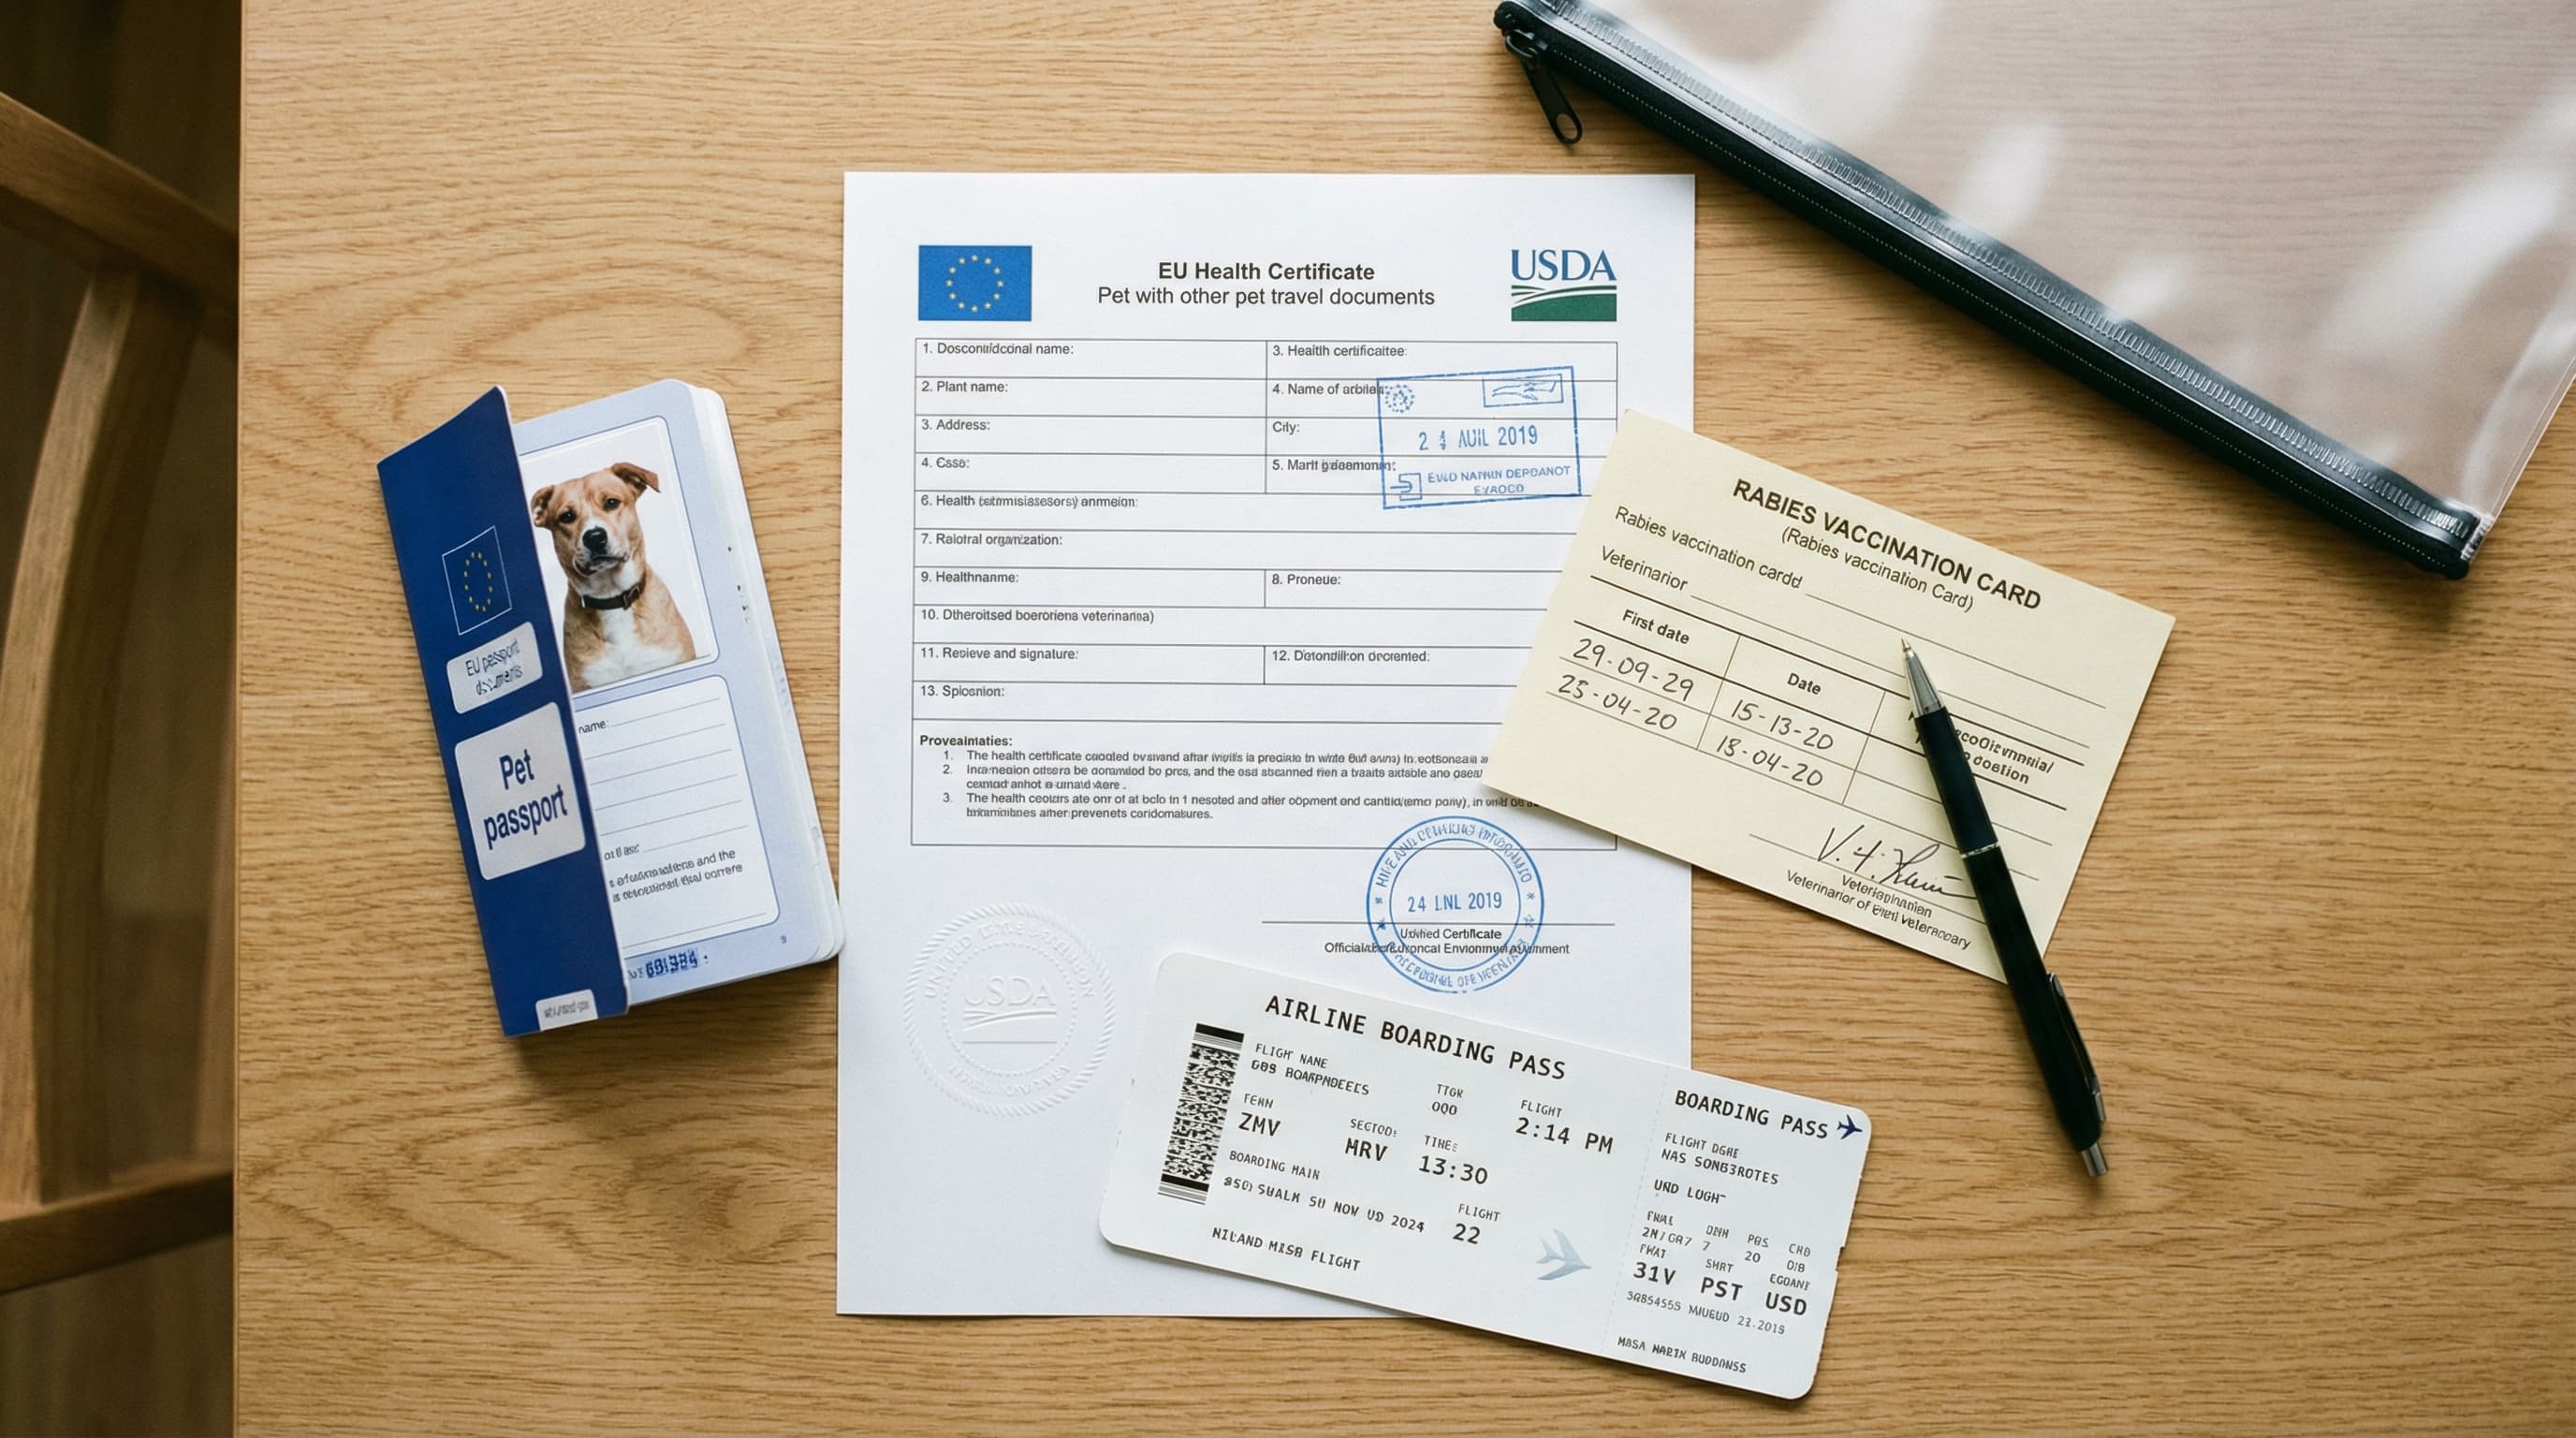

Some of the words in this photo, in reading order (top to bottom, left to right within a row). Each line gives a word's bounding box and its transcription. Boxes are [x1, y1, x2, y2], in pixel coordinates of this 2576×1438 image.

[1159, 262, 1187, 280] EU
[1195, 262, 1261, 280] Health
[1268, 262, 1375, 280] Certificate
[1512, 249, 1617, 281] USDA
[1099, 286, 1130, 304] Pet
[1135, 286, 1174, 304] with
[1180, 287, 1230, 304] other
[1236, 288, 1266, 309] pet
[1271, 287, 1323, 304] travel
[1329, 287, 1435, 305] documents
[923, 343, 932, 354] 1.
[1036, 345, 1074, 355] name:
[1273, 345, 1283, 356] 3.
[921, 380, 932, 392] 2.
[937, 381, 968, 392] Plant
[971, 383, 1009, 393] name:
[1272, 383, 1283, 394] 4.
[1288, 383, 1324, 394] Name
[1327, 383, 1339, 394] of
[922, 418, 932, 430] 3.
[936, 419, 990, 431] Address:
[1418, 432, 1428, 451] 2
[1498, 425, 1538, 447] 2019
[921, 457, 932, 468] 4.
[1272, 459, 1283, 471] 5.
[936, 494, 975, 506] Health
[921, 533, 932, 544] 7.
[1616, 506, 1667, 537] Rabies
[1672, 530, 1755, 571] vaccination
[1733, 478, 1817, 528] RABIES
[1824, 511, 1972, 584] VACCINATION
[1977, 573, 2041, 609] CARD
[921, 571, 931, 582] 9.
[1782, 525, 1839, 559] (Rabies
[1845, 551, 1927, 593] vaccination
[1932, 583, 1973, 613] Card)
[1272, 573, 1282, 584] 8.
[921, 609, 939, 620] 10.
[1622, 609, 1655, 635] First
[1652, 624, 1690, 644] date
[921, 647, 939, 659] 11.
[994, 647, 1017, 659] and
[1273, 650, 1290, 661] 12.
[921, 684, 938, 697] 13.
[1787, 672, 1822, 696] Date
[966, 750, 988, 760] The
[991, 750, 1026, 761] health
[500, 749, 534, 789] Pet
[1074, 765, 1088, 775] be
[1193, 766, 1215, 776] and
[1218, 767, 1236, 776] the
[966, 792, 988, 803] The
[991, 793, 1026, 803] health
[1237, 795, 1258, 805] and
[484, 785, 568, 850] passport
[1408, 896, 1427, 913] 24
[1468, 891, 1503, 910] 2019
[1857, 898, 1873, 911] of
[963, 976, 1057, 1006] USDA
[1266, 995, 1367, 1034] AIRLINE
[1381, 1020, 1495, 1064] BOARDING
[1509, 1050, 1565, 1079] PASS
[1521, 1100, 1562, 1118] FLIGHT
[1675, 1090, 1770, 1125] BOARDING
[1780, 1114, 1828, 1138] PASS
[1238, 1112, 1281, 1137] ZMV
[1515, 1117, 1570, 1145] 2:14
[1585, 1132, 1613, 1154] PM
[1665, 1133, 1706, 1151] FLIGHT
[1229, 1151, 1285, 1172] BOARDING
[1419, 1155, 1487, 1184] 13:30
[1458, 1203, 1500, 1221] FLIGHT
[1391, 1215, 1425, 1233] 2024
[1453, 1223, 1480, 1244] 22
[1310, 1250, 1361, 1270] FLIGHT
[1745, 1251, 1761, 1263] 20
[1633, 1261, 1676, 1285] 31V
[1701, 1276, 1743, 1301] PST
[1765, 1292, 1807, 1315] USD
